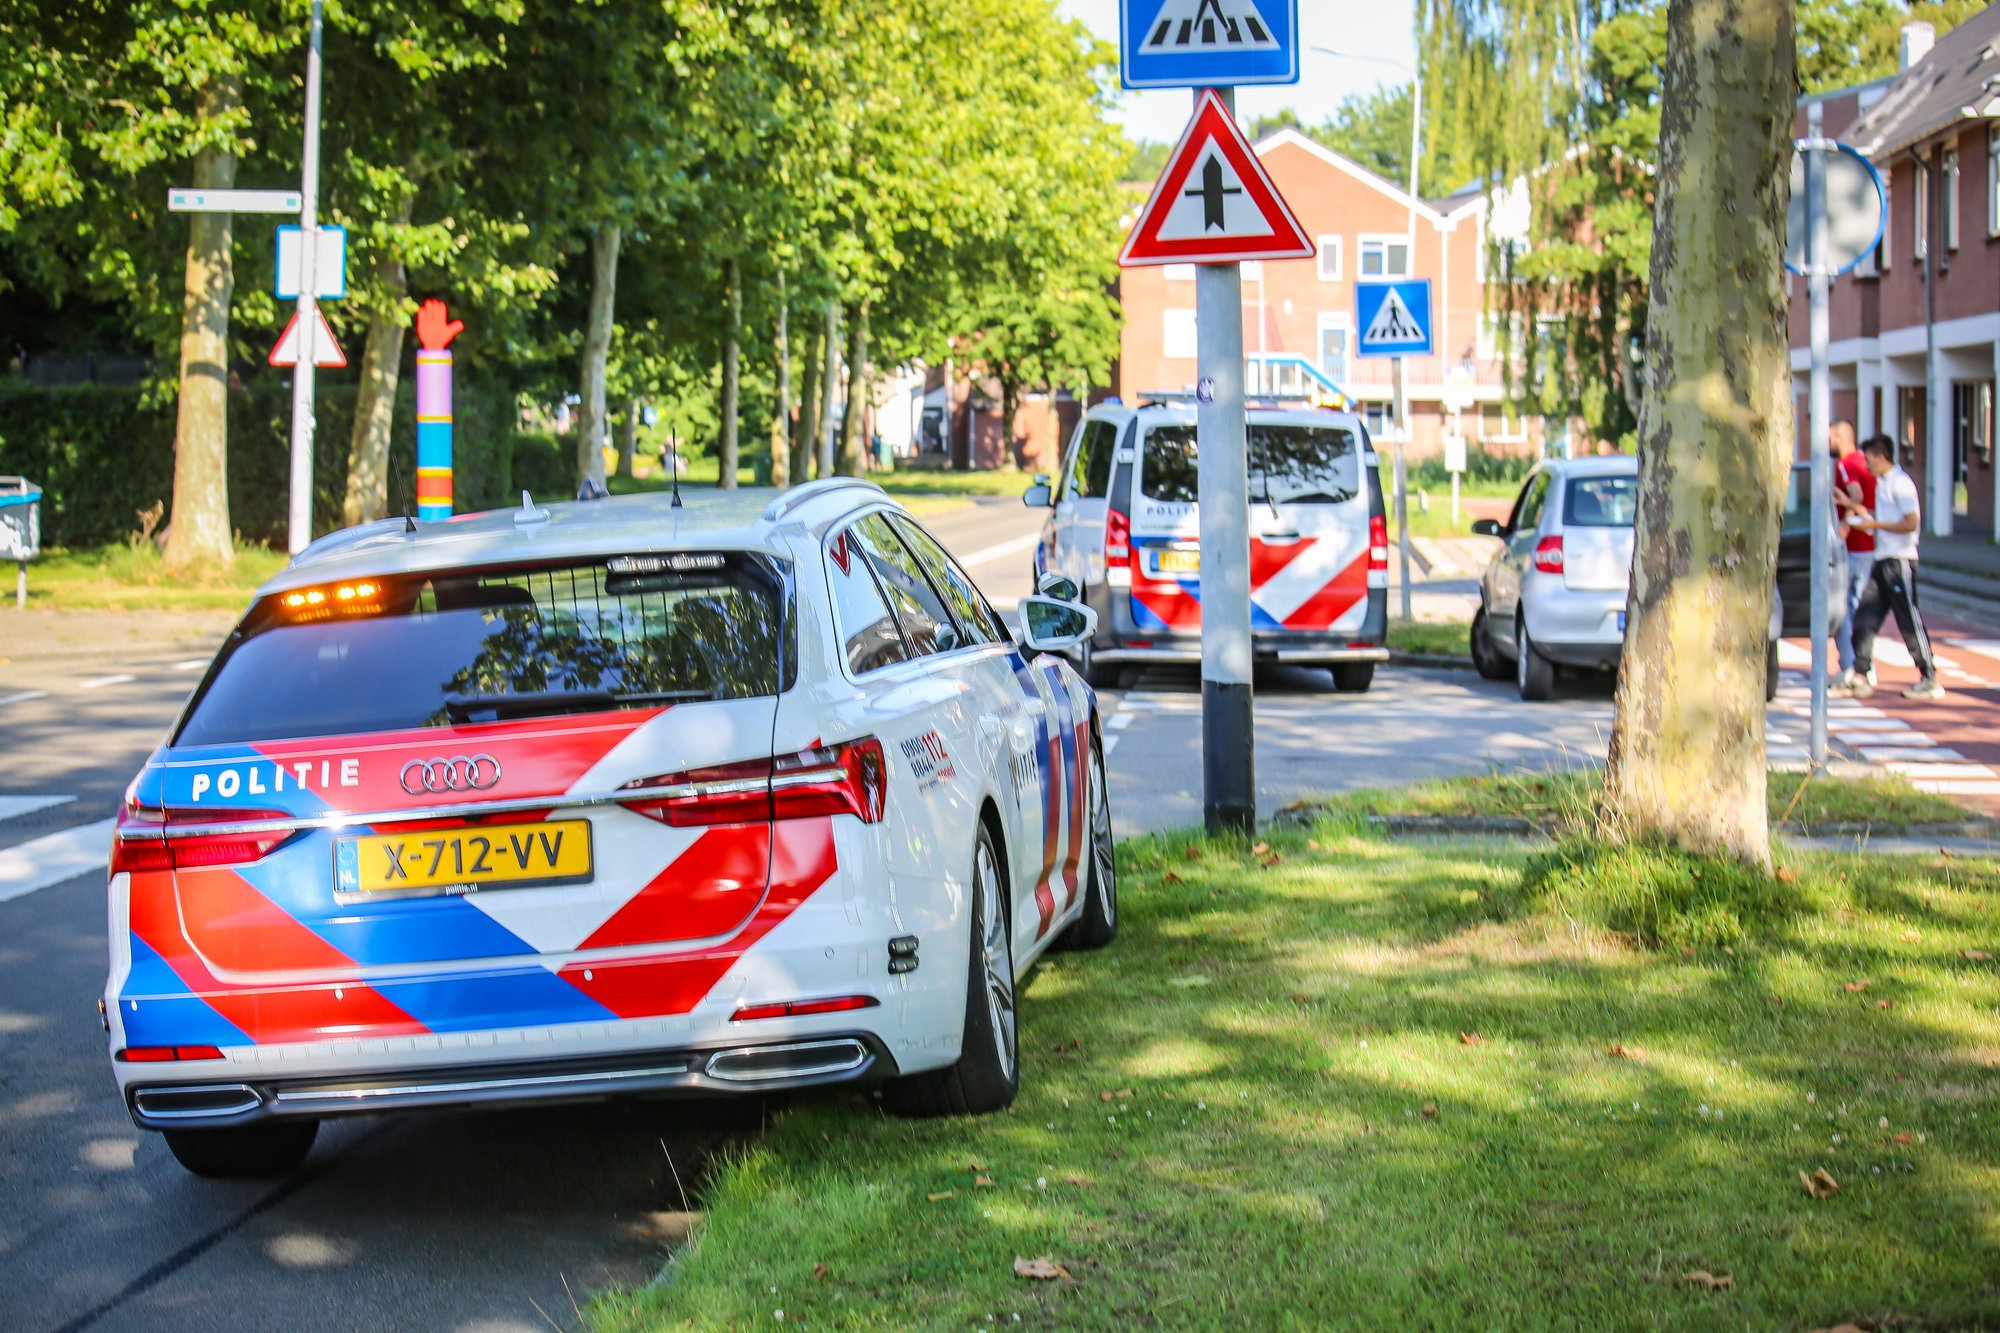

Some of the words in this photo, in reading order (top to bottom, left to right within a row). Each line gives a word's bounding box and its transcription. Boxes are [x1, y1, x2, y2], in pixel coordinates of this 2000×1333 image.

[1147, 506, 1196, 516] POLITI
[900, 736, 925, 759] 0900
[921, 730, 948, 763] 112
[192, 758, 360, 802] POLITIE
[383, 831, 564, 881] X-712-VV
[340, 870, 357, 887] NL
